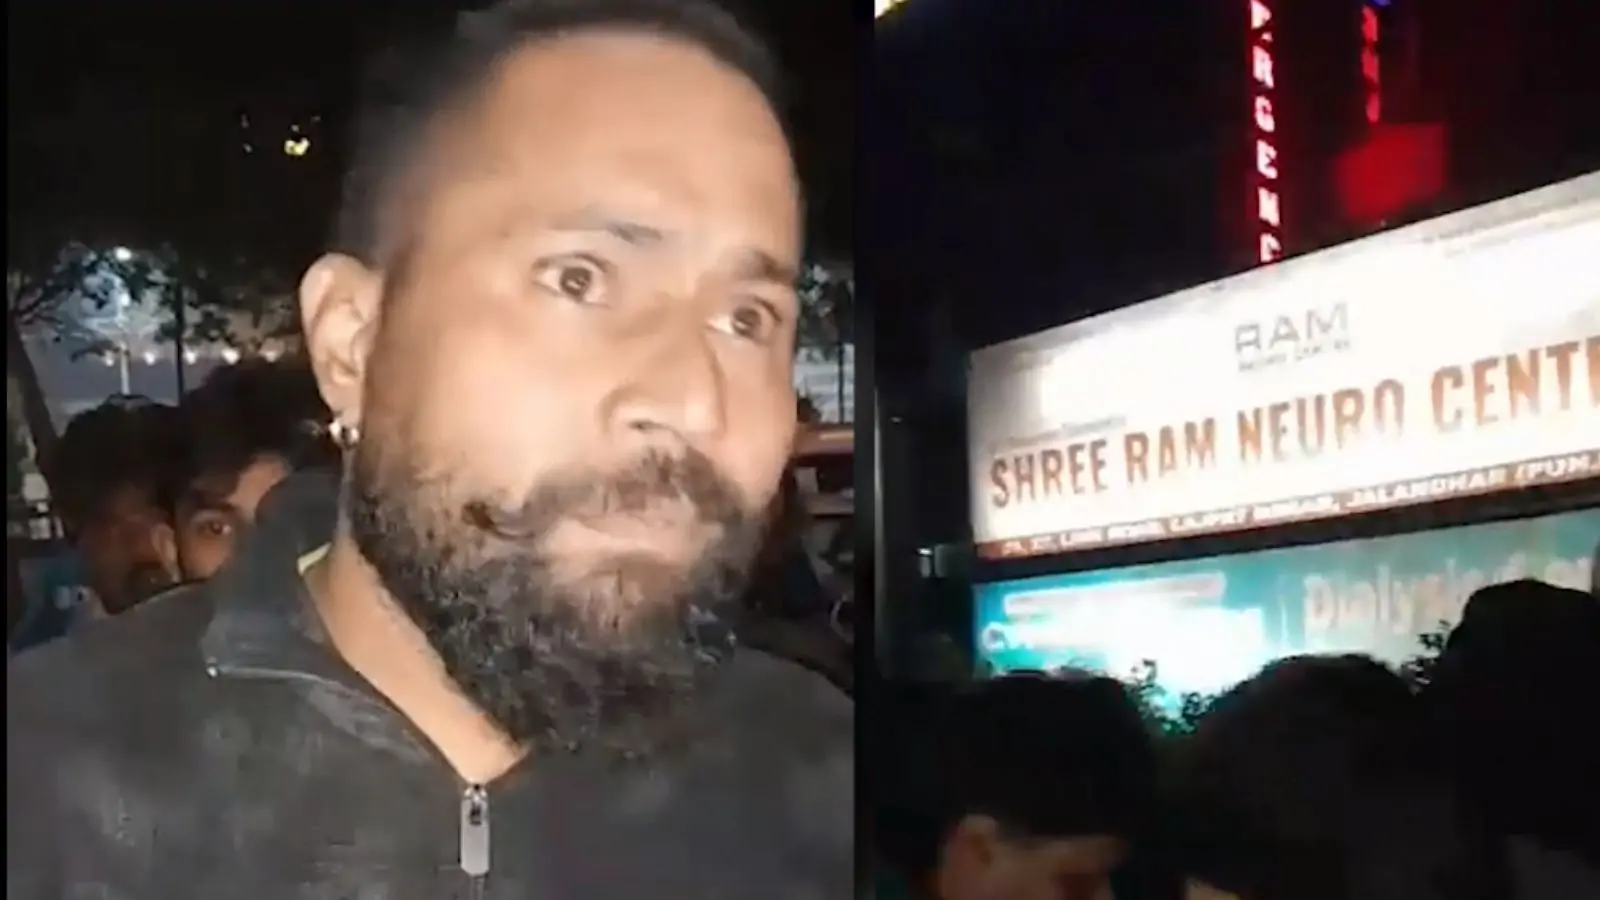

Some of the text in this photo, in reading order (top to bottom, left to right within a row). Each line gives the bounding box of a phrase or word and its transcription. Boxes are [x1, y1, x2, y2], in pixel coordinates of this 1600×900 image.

[1235, 303, 1349, 354] RAM
[988, 439, 1109, 509] SHREE
[1123, 417, 1217, 483] RAM
[1237, 377, 1406, 464] NEURO
